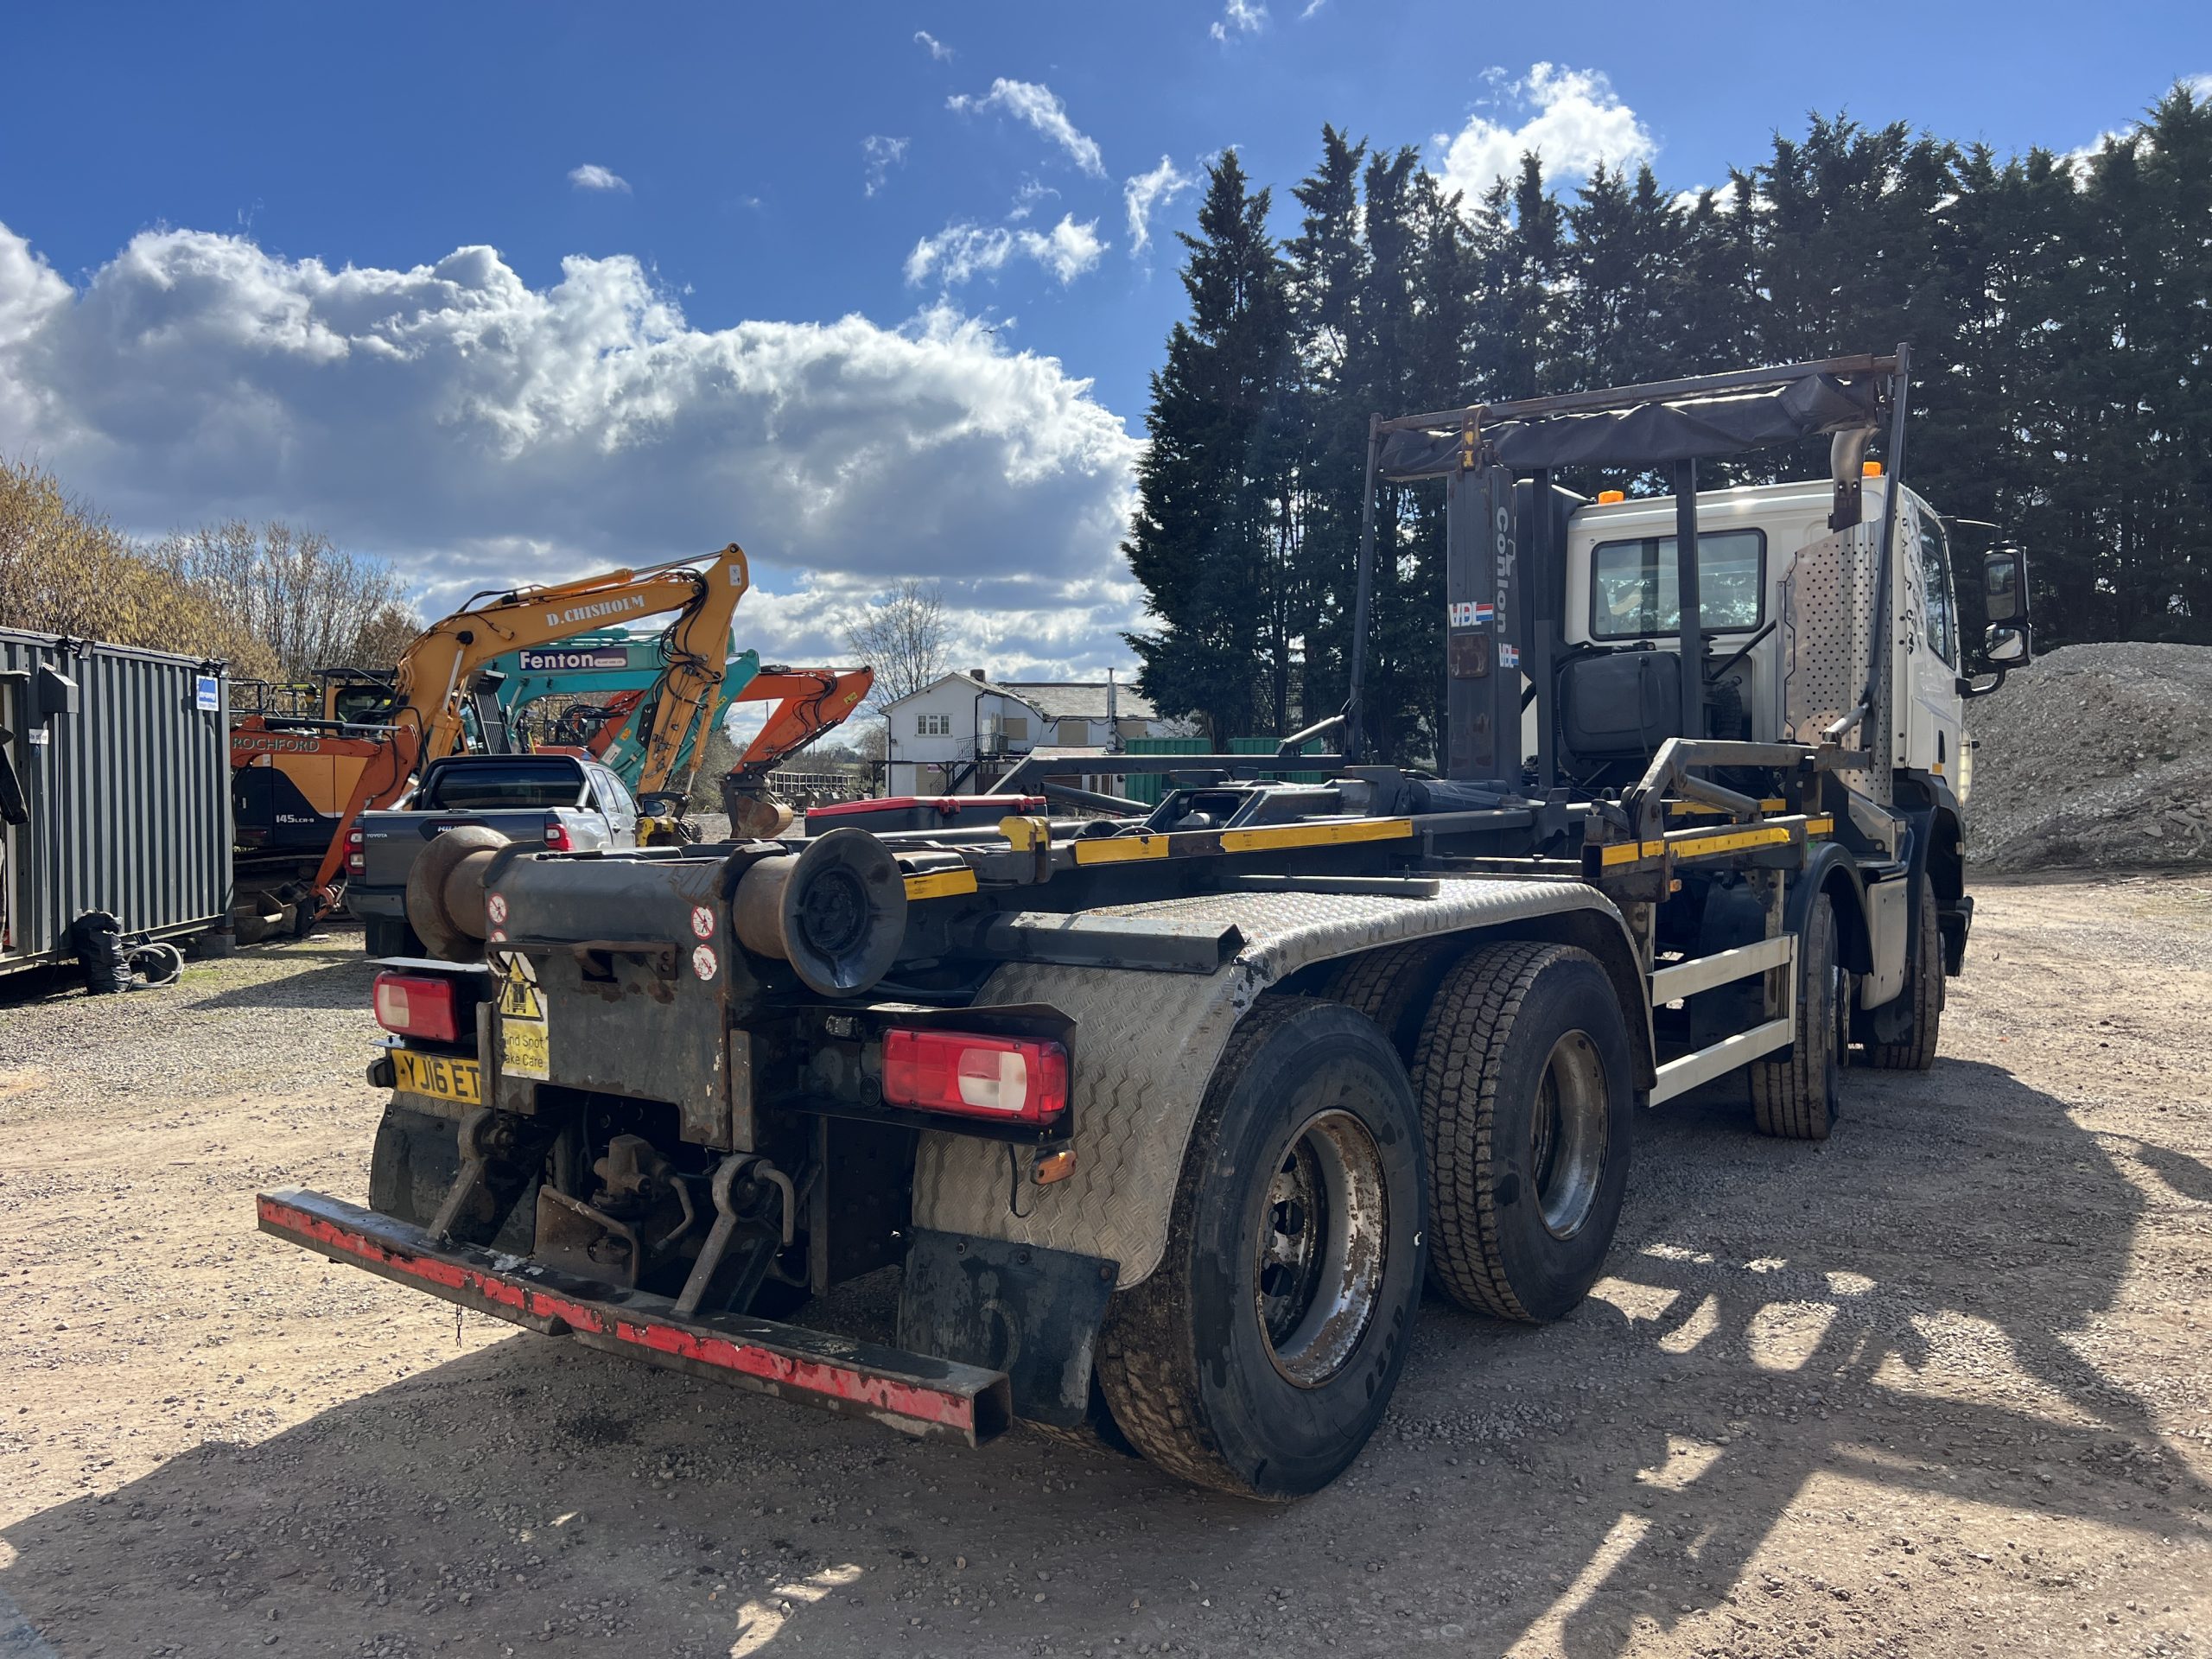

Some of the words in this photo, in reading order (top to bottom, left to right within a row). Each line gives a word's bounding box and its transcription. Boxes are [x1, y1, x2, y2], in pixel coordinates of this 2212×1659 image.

[1497, 506, 1509, 633] Conlon
[1449, 601, 1482, 628] VDL
[519, 651, 594, 670] Fenton
[1498, 642, 1515, 668] VDL
[232, 737, 321, 753] ROCHFORD
[505, 1034, 520, 1046] ind
[523, 1035, 543, 1050] Spot
[505, 1052, 520, 1065] ake
[523, 1053, 543, 1068] Care
[404, 1055, 448, 1094] YJ16
[450, 1064, 480, 1099] ET
